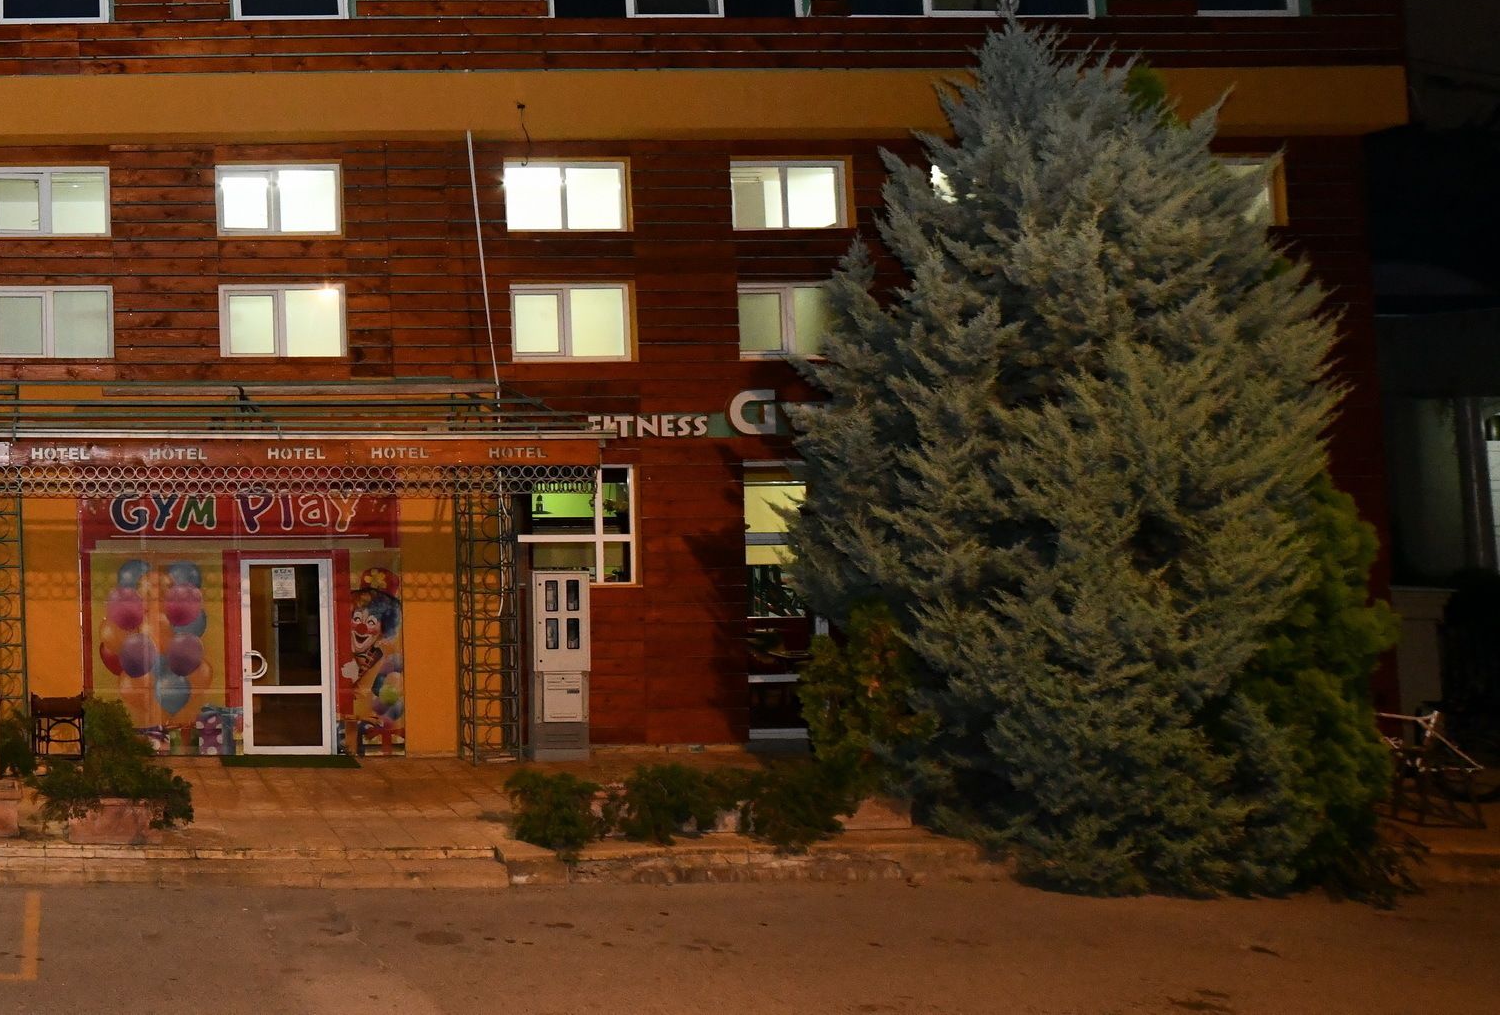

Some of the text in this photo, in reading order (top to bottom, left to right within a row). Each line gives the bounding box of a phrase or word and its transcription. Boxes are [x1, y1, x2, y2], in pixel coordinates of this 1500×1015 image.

[587, 415, 708, 437] FITNESS
[30, 447, 90, 460] HOTEL
[148, 447, 208, 460] HOTEL
[266, 447, 326, 460] HOTEL
[370, 447, 430, 460] HOTEL
[487, 447, 547, 460] HOTEL
[110, 488, 217, 532] GYM
